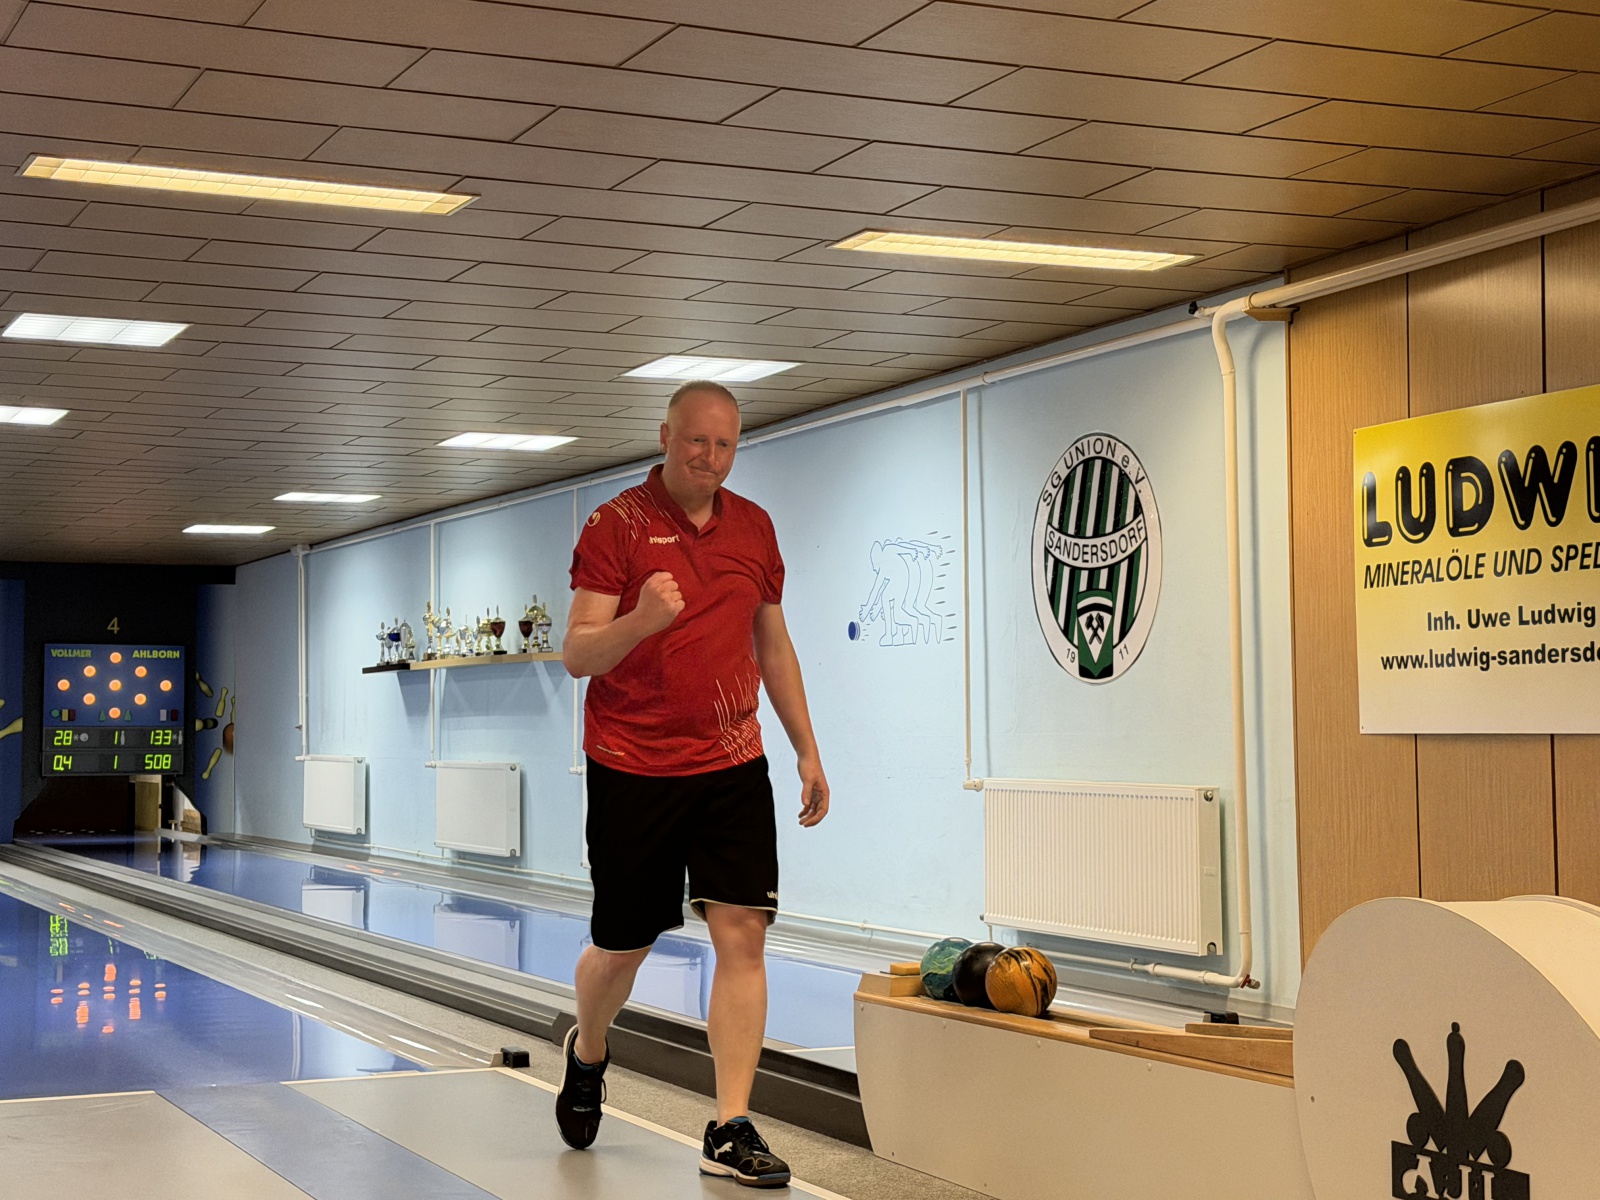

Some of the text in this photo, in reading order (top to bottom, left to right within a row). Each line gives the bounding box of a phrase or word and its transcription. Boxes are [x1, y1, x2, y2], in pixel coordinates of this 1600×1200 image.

[1042, 471, 1062, 507] SG
[1063, 438, 1117, 470] UNION
[1046, 519, 1145, 563] SANDERSDORF
[1364, 548, 1486, 589] MINERALÖLE
[1493, 547, 1543, 578] UND
[107, 617, 120, 634] 4
[1427, 601, 1596, 632] Inh. Uwe Ludwig
[51, 649, 92, 658] VOLLMER
[132, 650, 180, 659] AHLBORN
[1065, 643, 1129, 663] 19 11
[1381, 640, 1600, 672] www.ludwig-sandersd
[54, 730, 73, 746] 28
[150, 730, 172, 745] 133
[144, 754, 172, 769] 508
